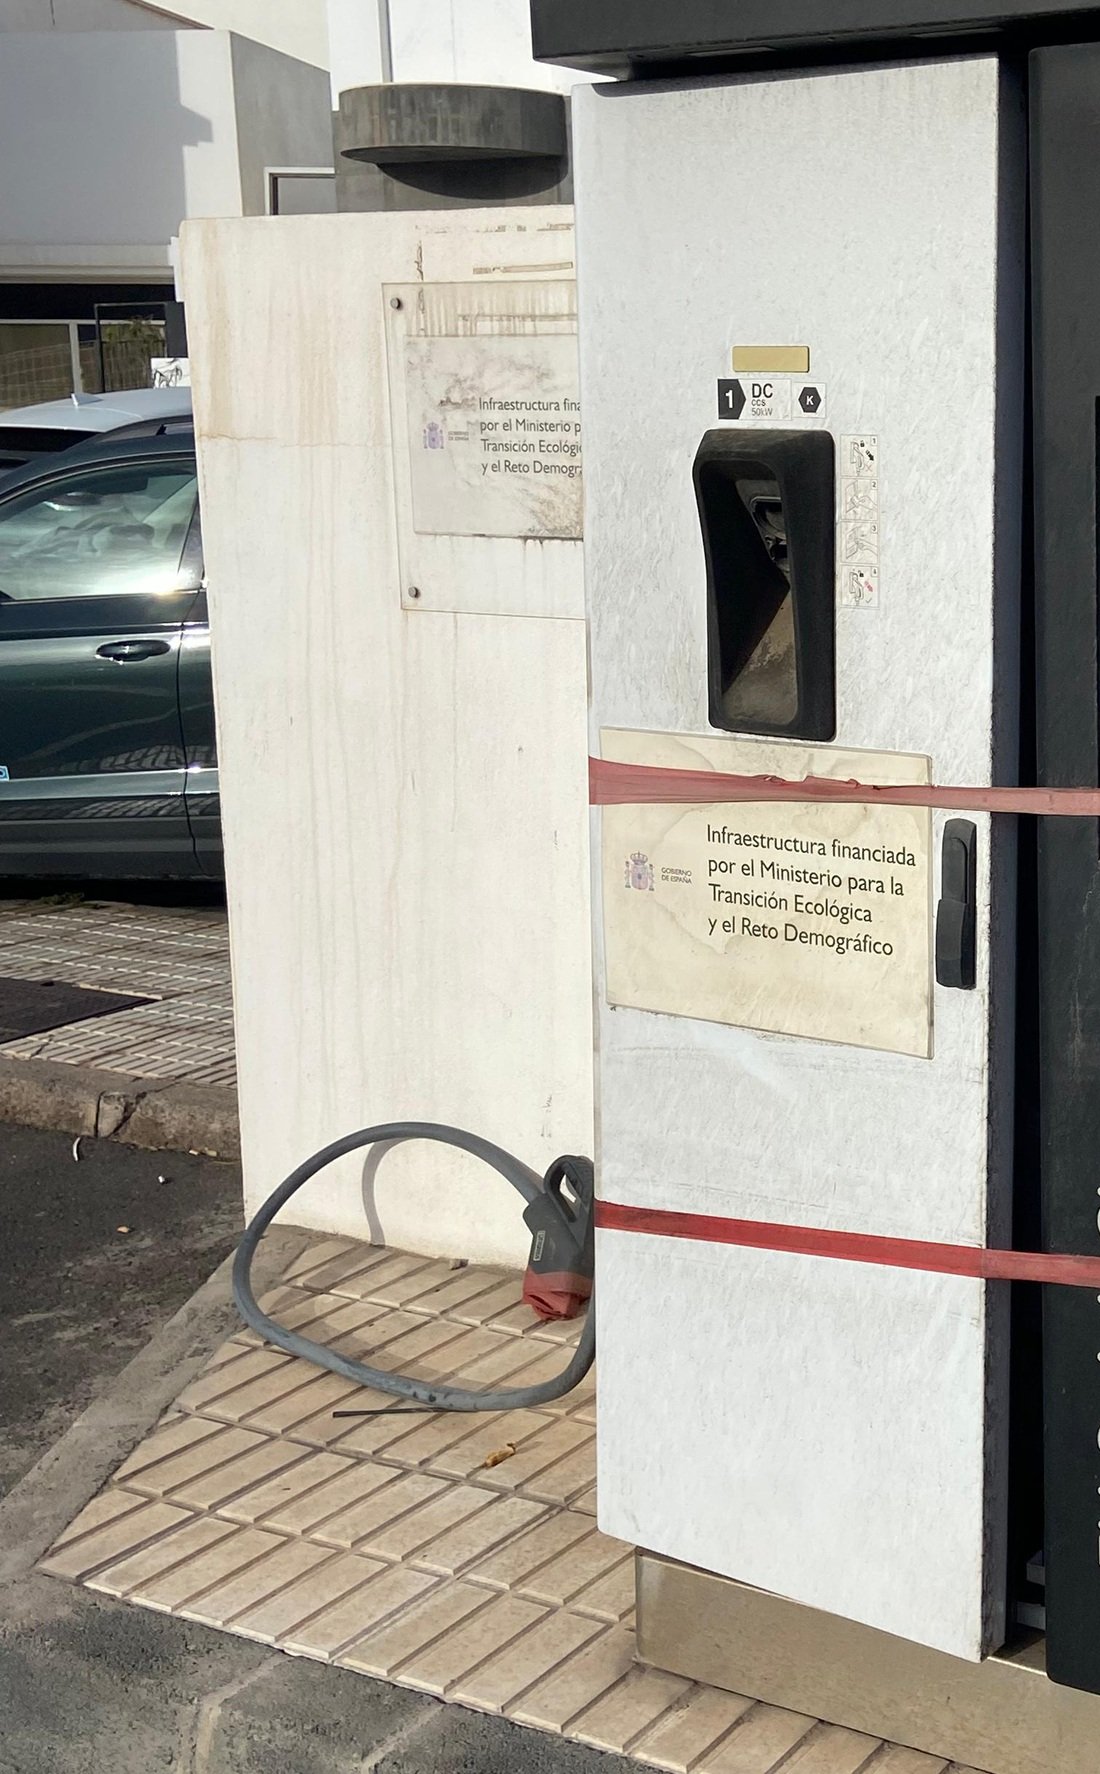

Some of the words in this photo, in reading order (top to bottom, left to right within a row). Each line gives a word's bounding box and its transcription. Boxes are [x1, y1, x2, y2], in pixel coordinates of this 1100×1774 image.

[479, 397, 560, 411] Infraestructura
[725, 389, 734, 409] 1
[751, 383, 774, 399] DC
[751, 399, 767, 407] CCS
[806, 395, 814, 406] K
[479, 422, 499, 434] por
[502, 418, 512, 432] el
[515, 419, 571, 432] Ministerio
[481, 438, 535, 453] Transición
[481, 462, 488, 475] y
[491, 461, 501, 473] el
[504, 461, 530, 473] Reto
[706, 824, 827, 857] Infraestructura
[831, 838, 917, 867] financiada
[708, 859, 736, 877] por
[741, 859, 755, 876] el
[760, 863, 842, 888] Ministerio
[847, 875, 885, 895] para
[890, 876, 904, 896] la
[708, 883, 788, 911] Transición
[794, 895, 873, 924] Ecológica
[708, 917, 717, 936] y
[722, 916, 736, 934] el
[741, 917, 779, 940] Reto
[784, 923, 894, 956] Demográfico
